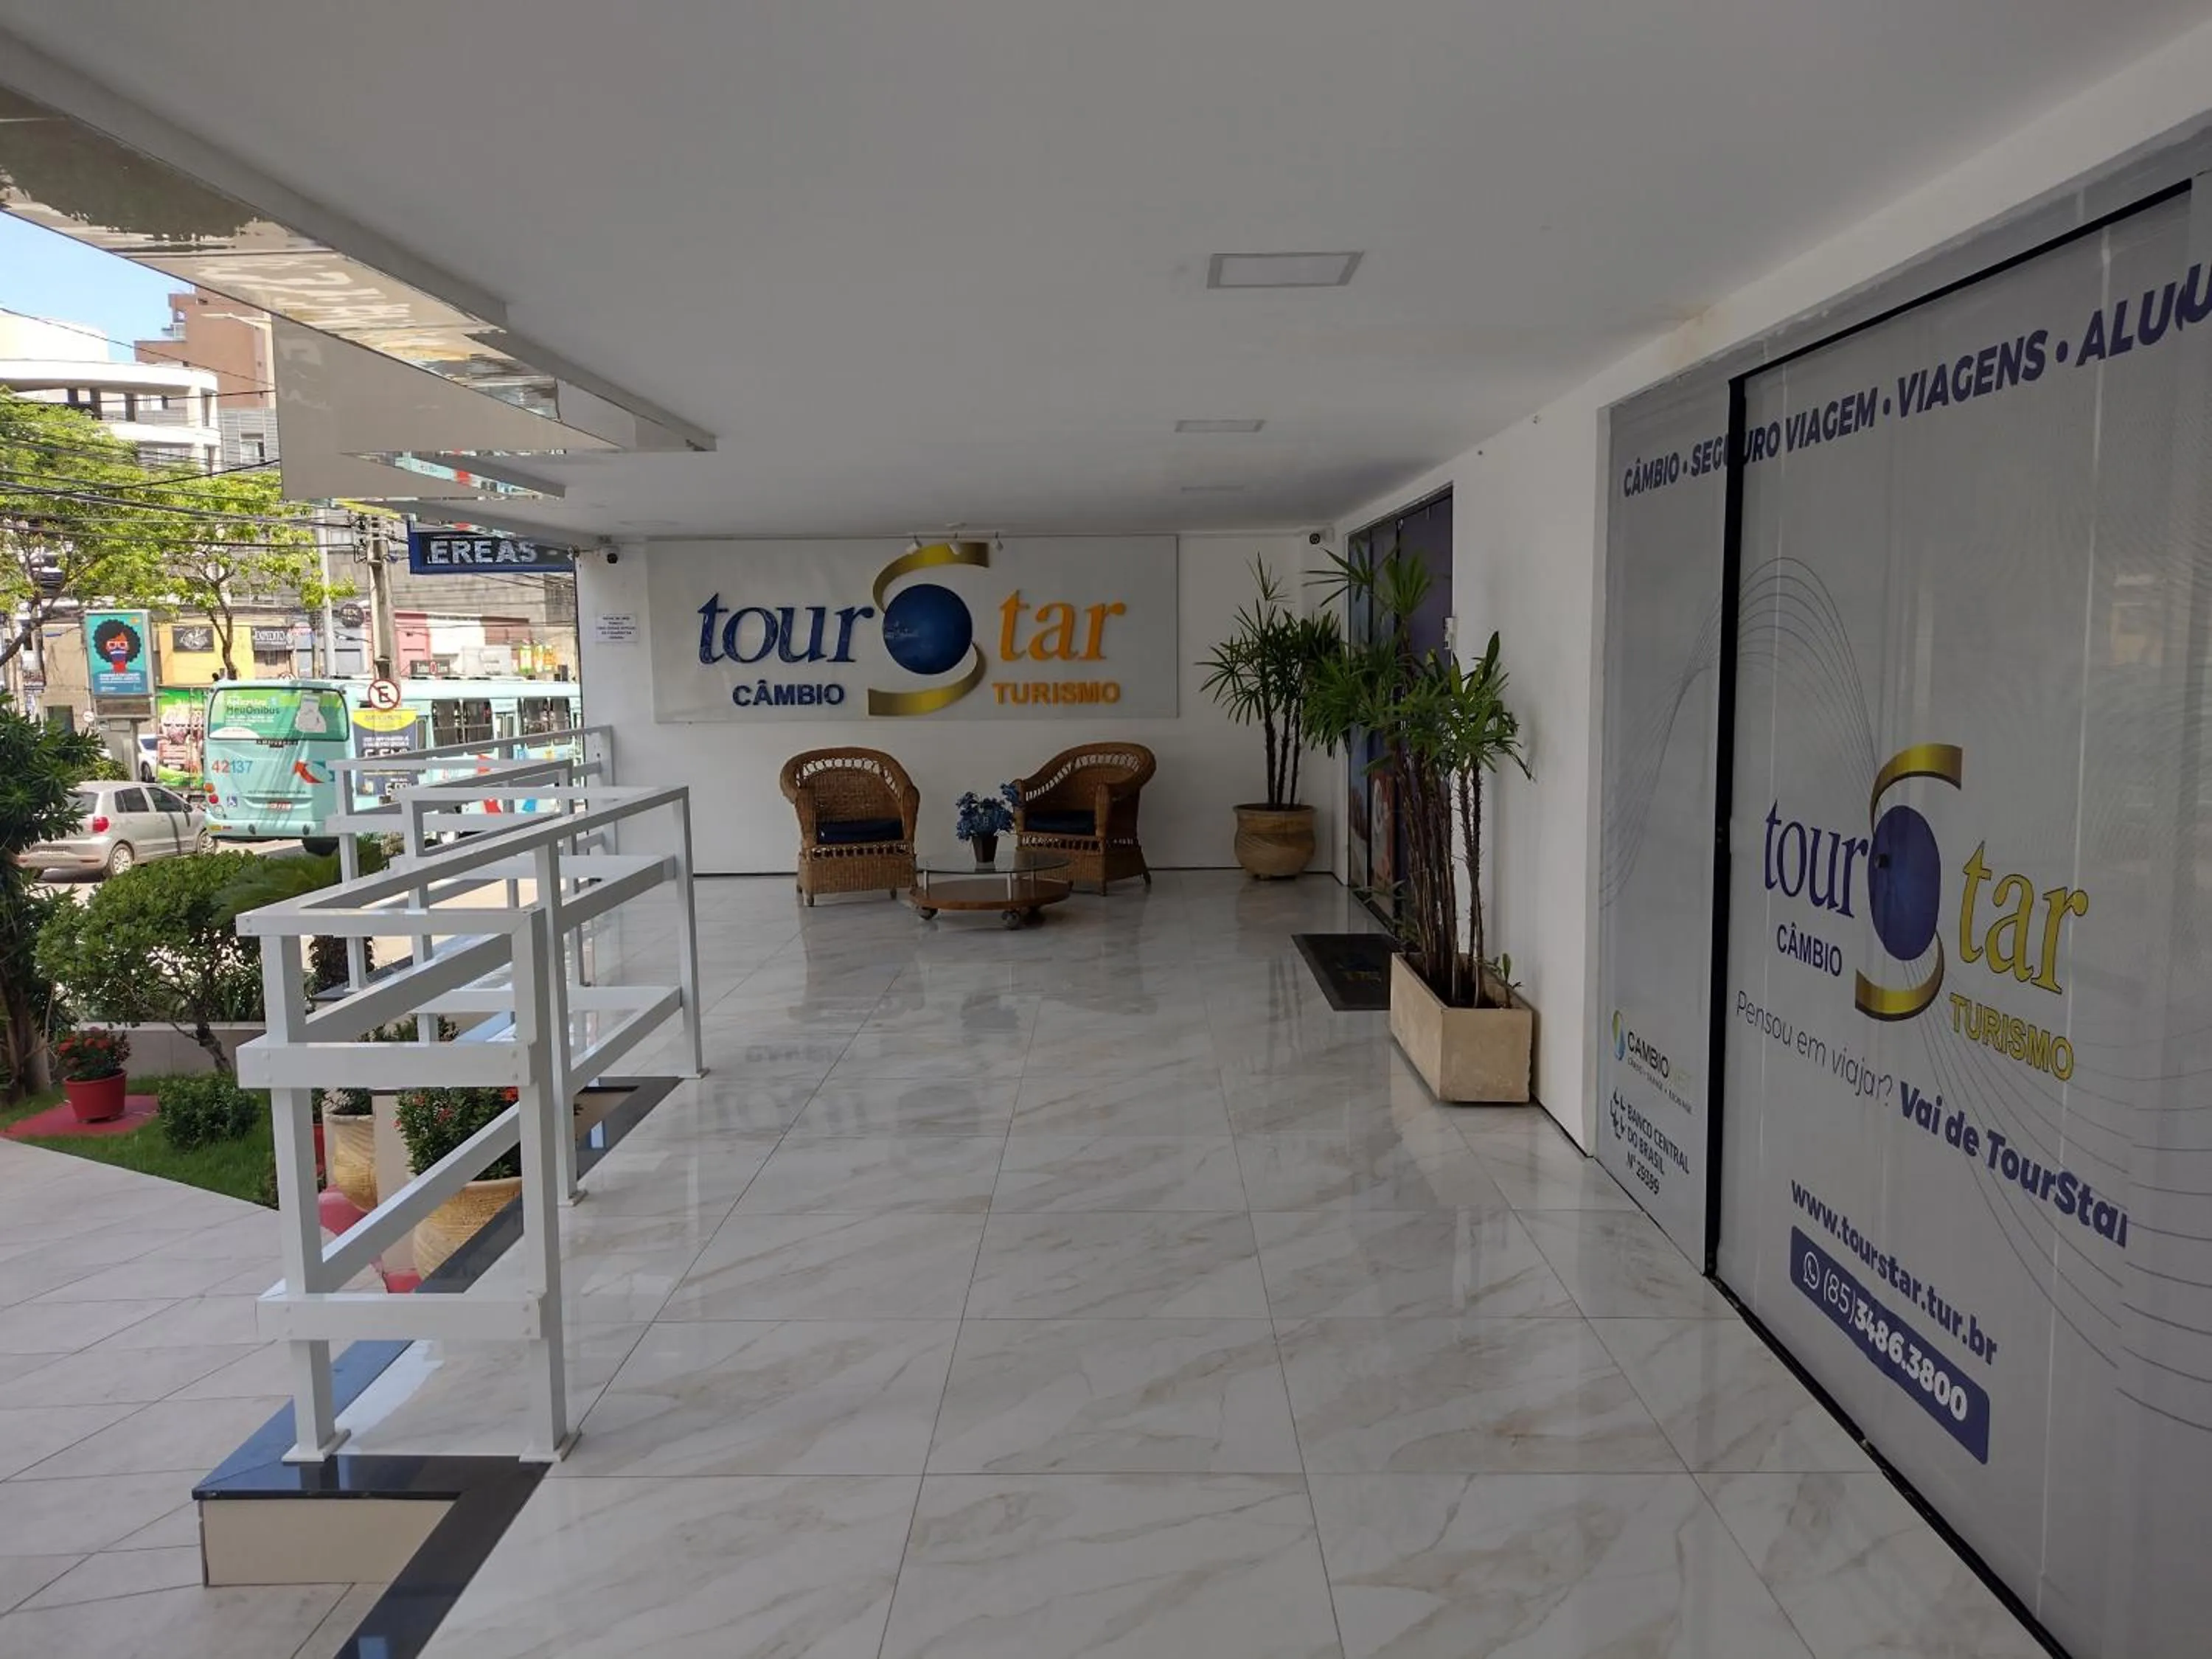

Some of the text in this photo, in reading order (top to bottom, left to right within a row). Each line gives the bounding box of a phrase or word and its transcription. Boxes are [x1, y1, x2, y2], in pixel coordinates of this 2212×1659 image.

[1623, 458, 1680, 498] CÂMBIO
[1787, 386, 1879, 453] VIAGEM
[1897, 330, 2049, 418] VIAGENS
[428, 539, 538, 565] EREAS
[731, 679, 1121, 707] CÂMBIO TURISMO
[212, 759, 254, 773] 42137
[1776, 922, 2075, 1082] CÂMBIO TURISMO
[1736, 990, 1794, 1047] Pensou
[1797, 1032, 1828, 1065] em
[1830, 1044, 1893, 1107] viajar?
[1899, 1081, 1942, 1135] Vai
[1944, 1110, 1980, 1157] de
[1627, 1105, 1690, 1175] BANCO CENTRAL
[1627, 1127, 1665, 1175] DO BRASIL
[1791, 1180, 1998, 1366] www.tourstar.tur.br
